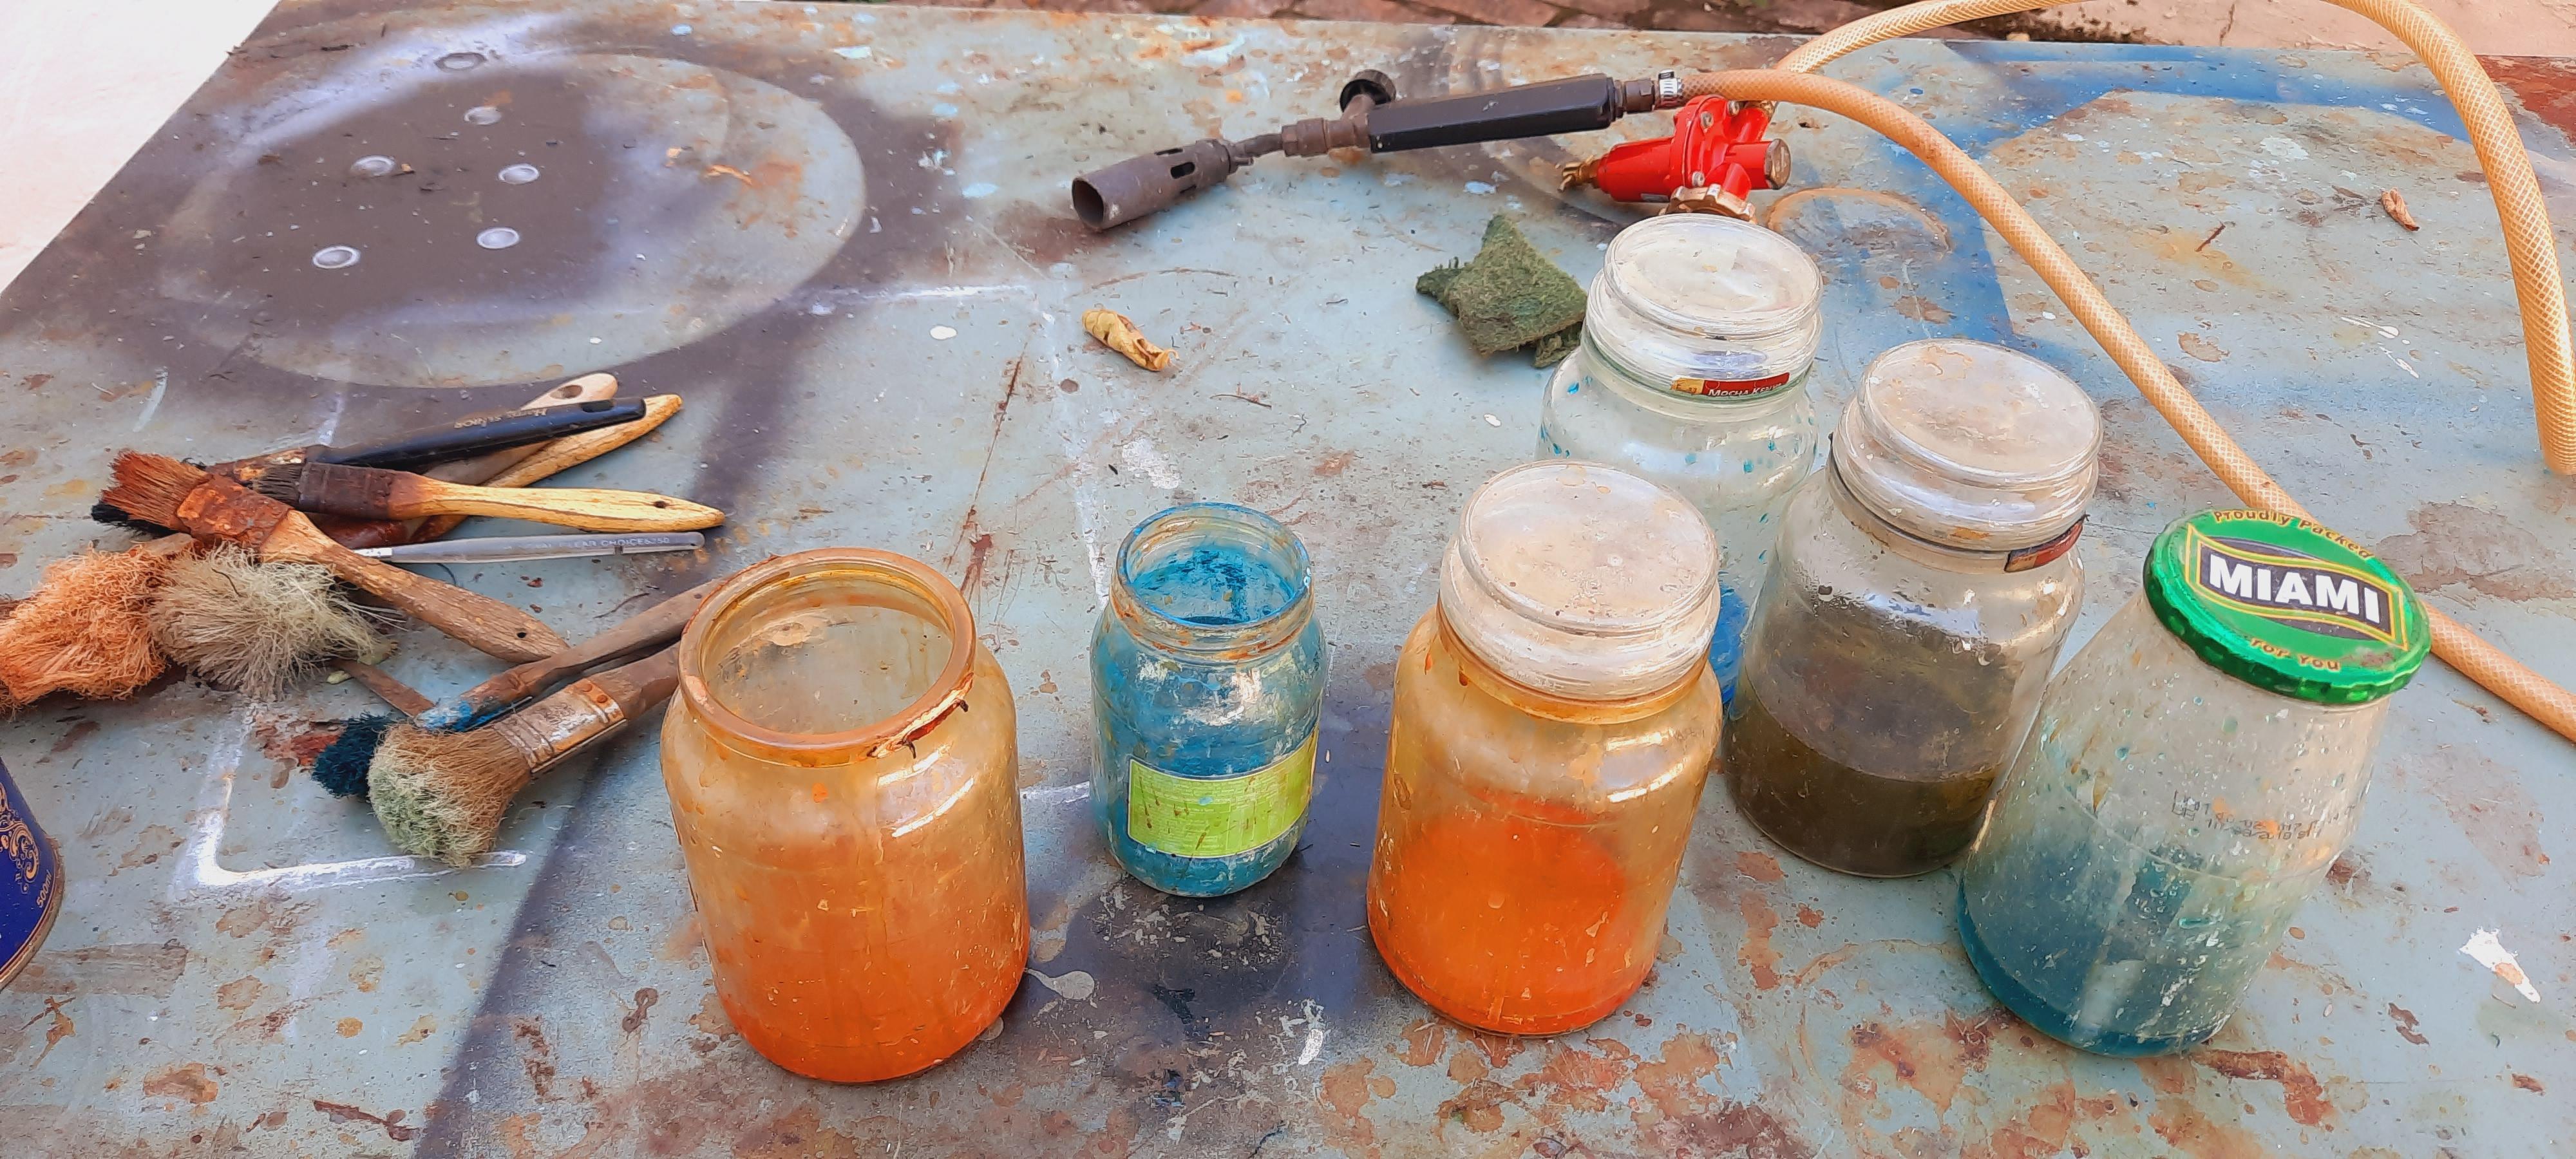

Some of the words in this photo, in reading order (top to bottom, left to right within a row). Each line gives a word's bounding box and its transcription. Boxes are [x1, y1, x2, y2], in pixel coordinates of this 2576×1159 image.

[2213, 509, 2291, 525] Proudly
[2298, 519, 2374, 560] Packed
[2210, 554, 2381, 624] MIAMI
[36, 869, 52, 908] 500ml
